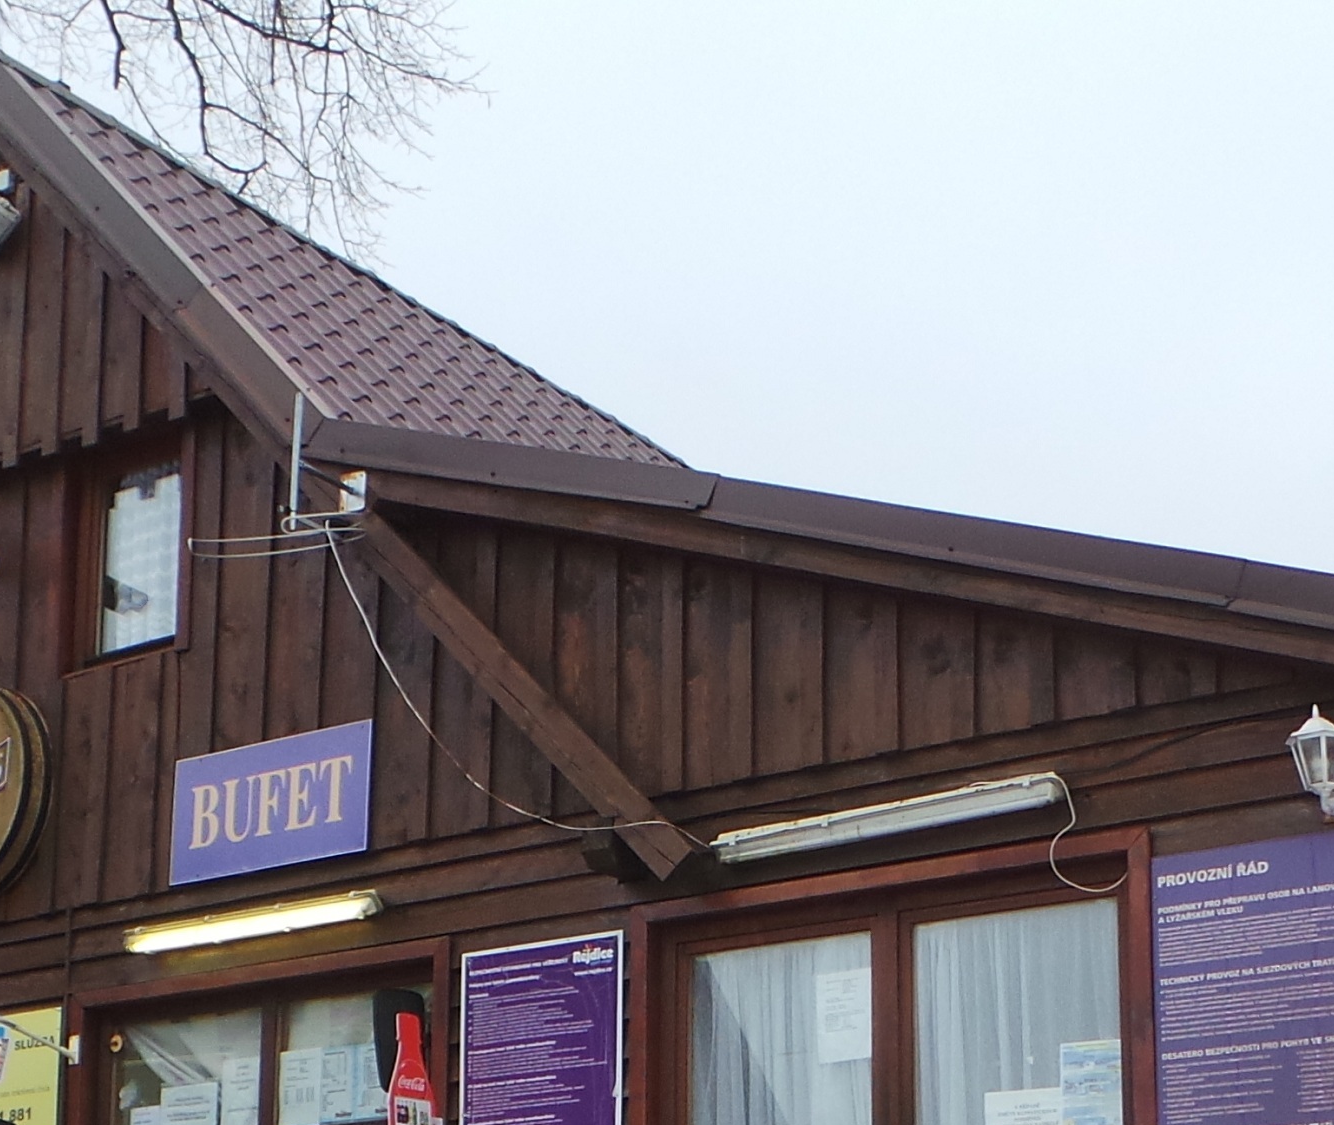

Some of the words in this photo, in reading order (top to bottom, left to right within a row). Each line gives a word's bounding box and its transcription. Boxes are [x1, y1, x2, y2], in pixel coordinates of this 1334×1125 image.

[188, 755, 353, 850] BUFET
[1157, 864, 1233, 888] PROVOZNÍ
[1236, 860, 1269, 877] ŘÁD
[1204, 899, 1221, 908] PRO
[1291, 887, 1306, 896] NA
[1158, 916, 1165, 924] A
[1241, 967, 1255, 976] NA
[1261, 1041, 1279, 1050] PRO
[1310, 1036, 1322, 1045] VE
[9, 1107, 31, 1123] 881
